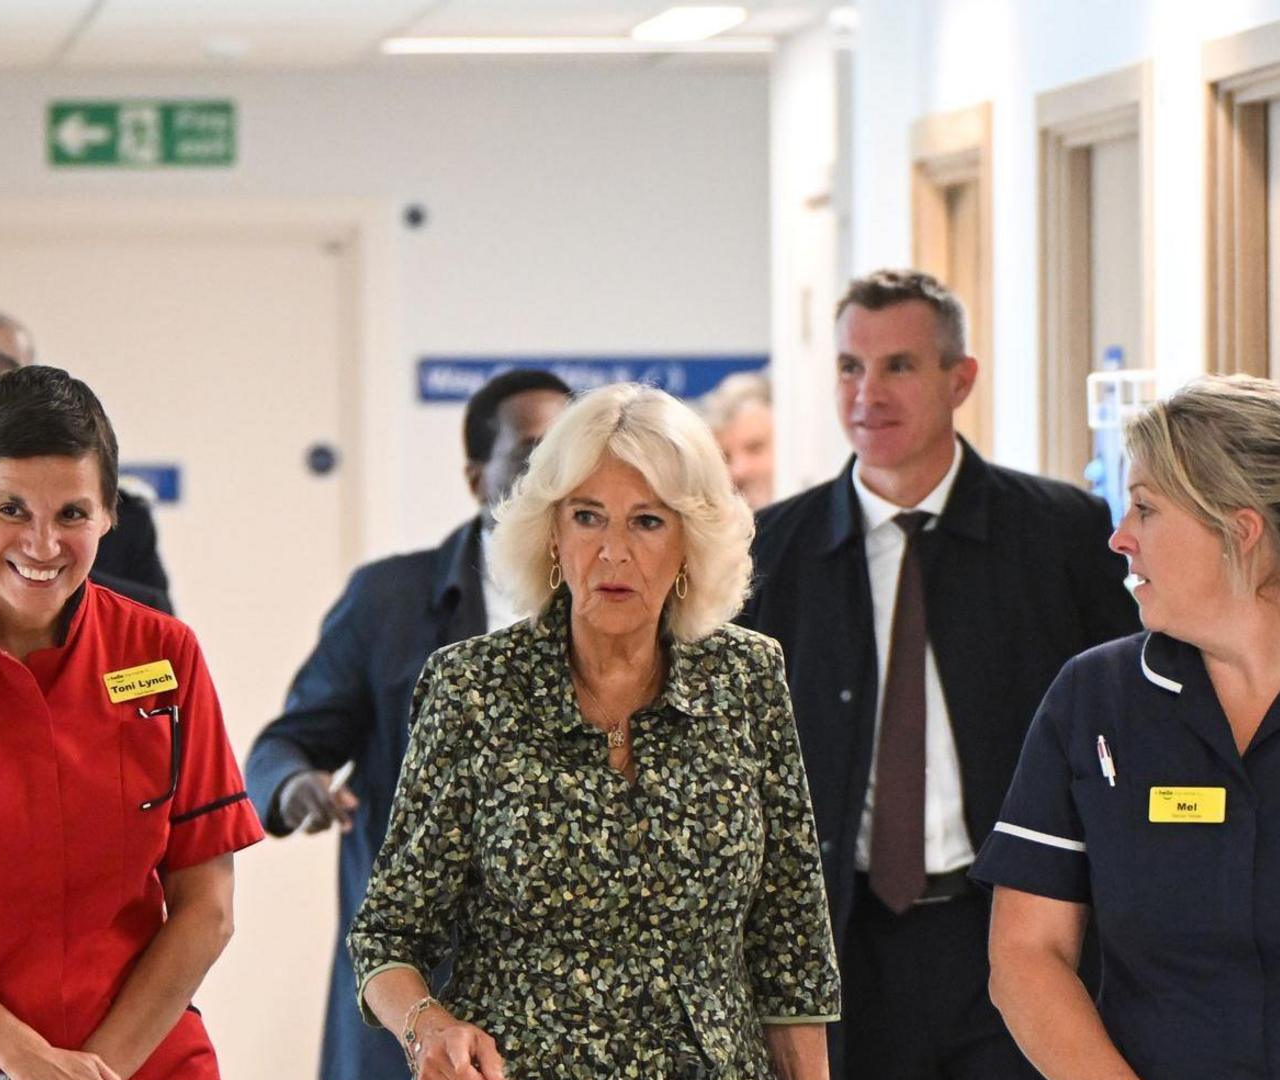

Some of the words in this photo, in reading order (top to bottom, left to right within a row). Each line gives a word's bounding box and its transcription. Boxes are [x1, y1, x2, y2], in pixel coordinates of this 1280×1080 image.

[111, 684, 136, 694] Toni
[138, 674, 173, 688] Lynch
[1177, 802, 1197, 812] Mel
